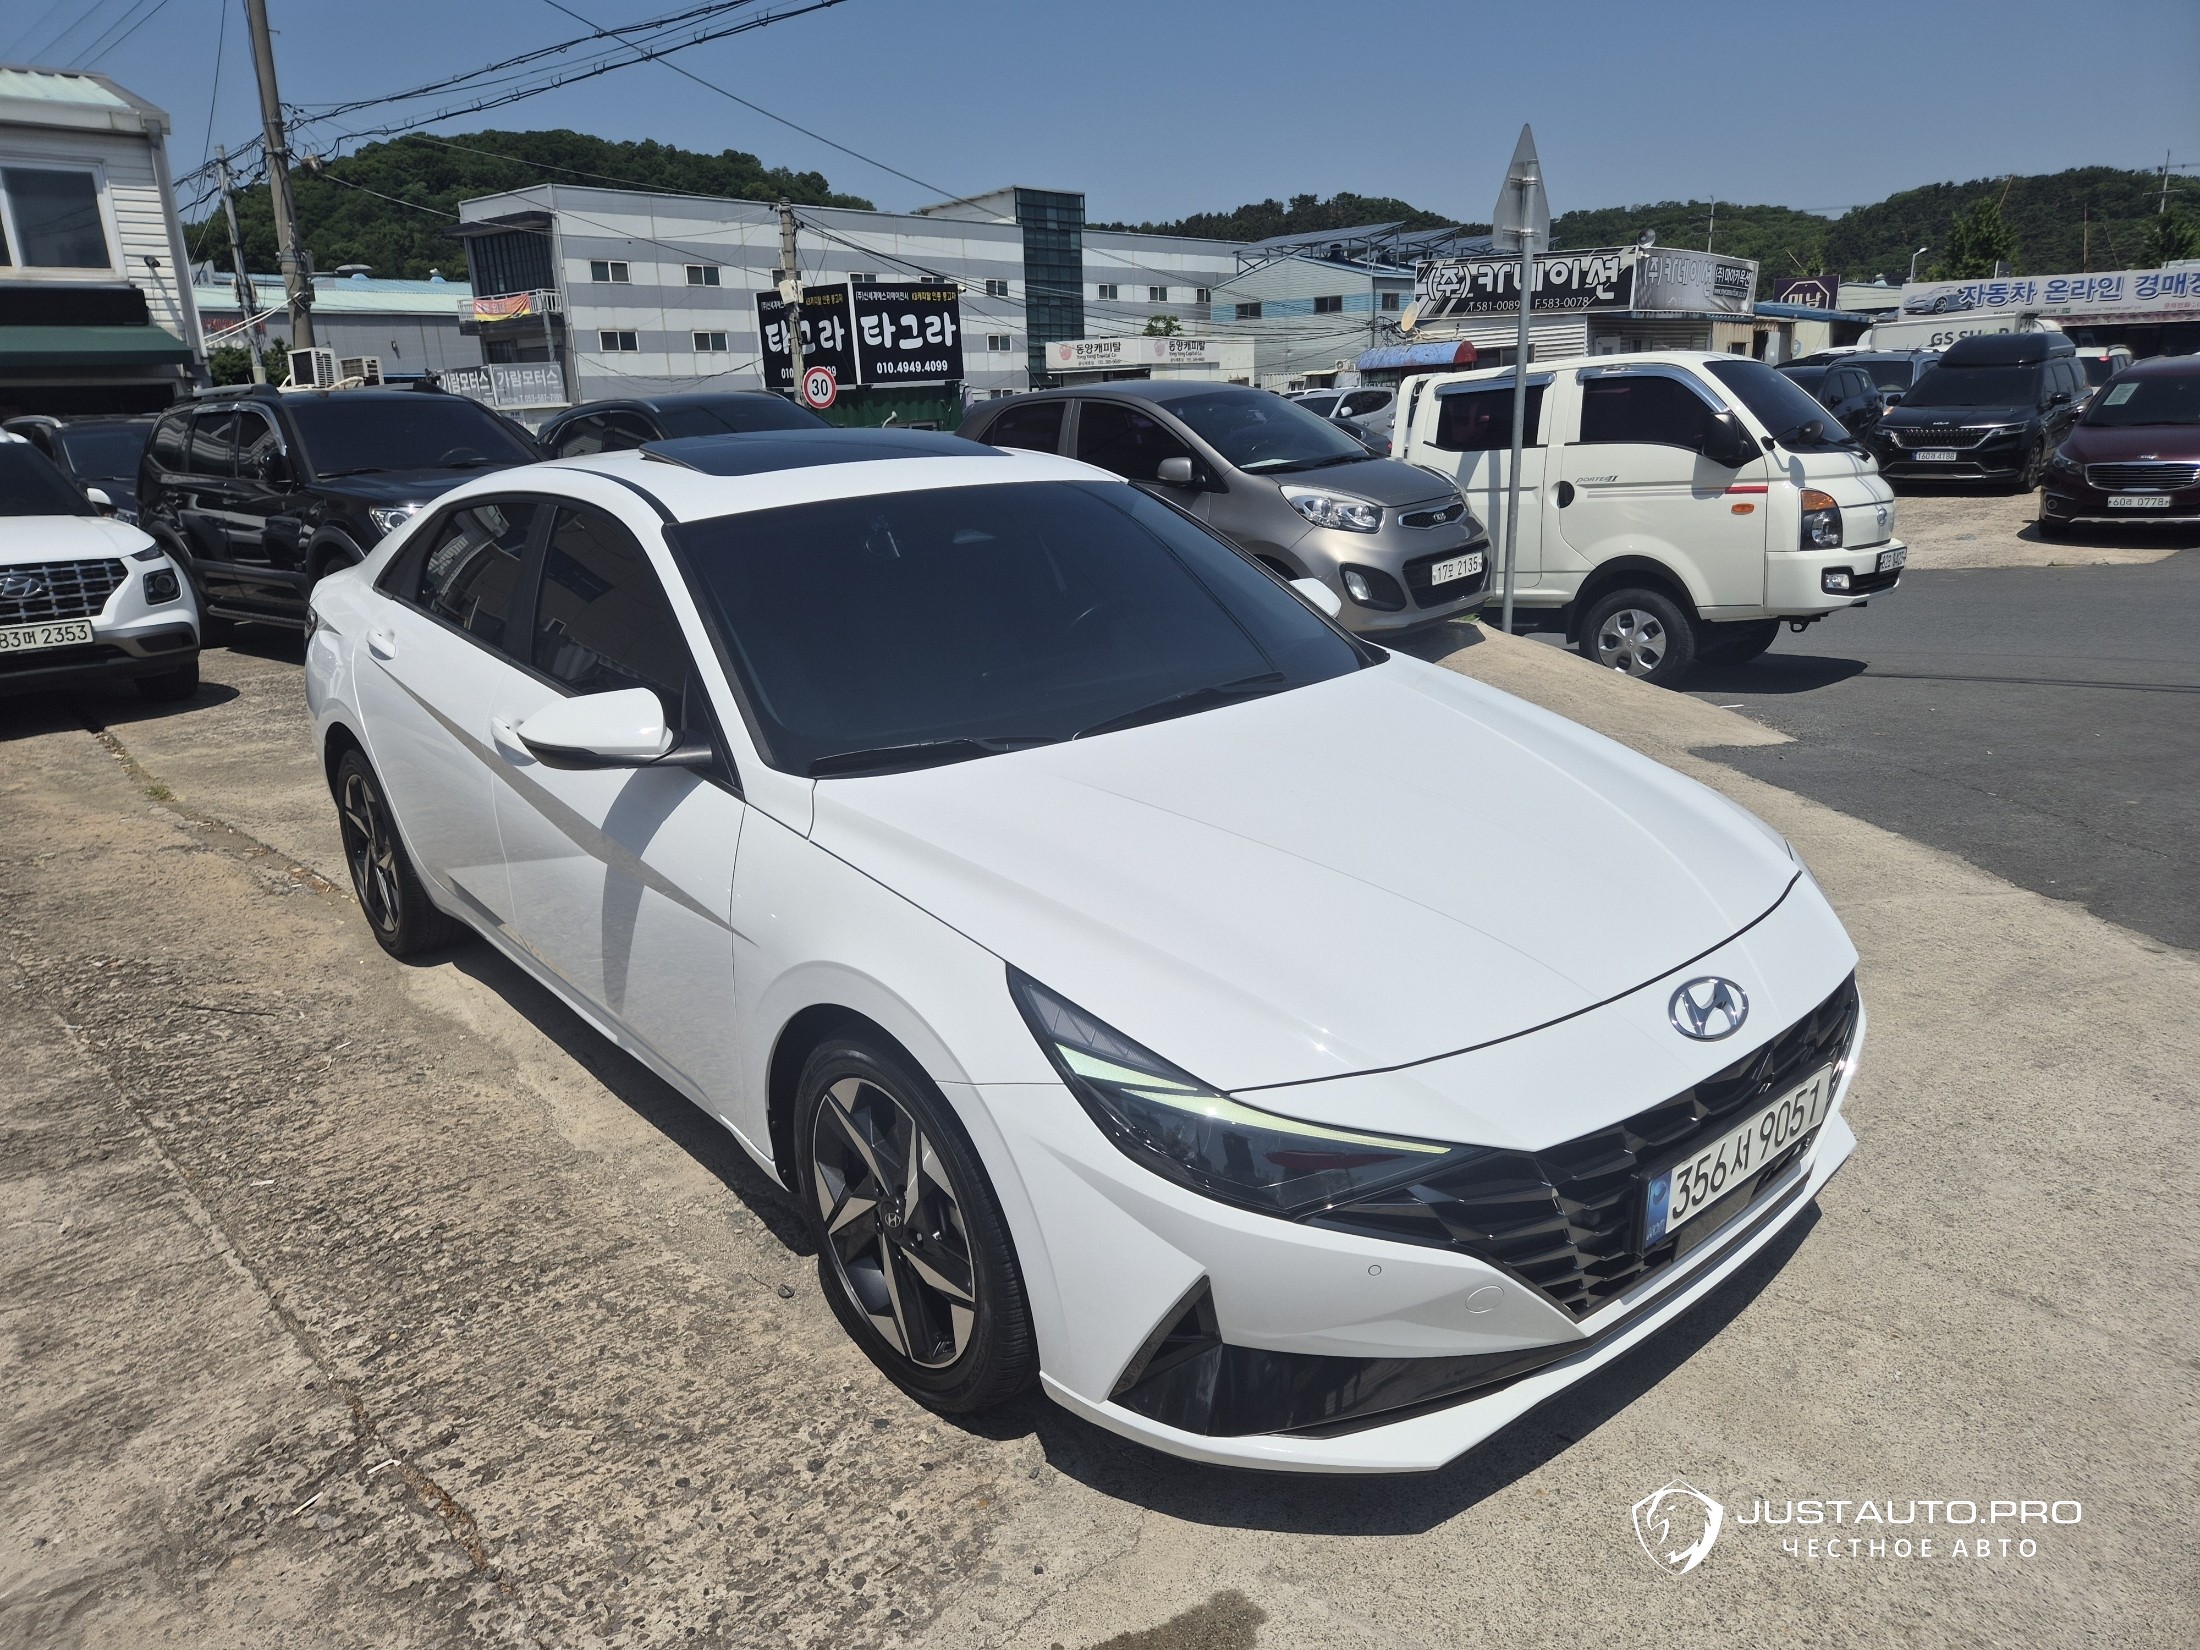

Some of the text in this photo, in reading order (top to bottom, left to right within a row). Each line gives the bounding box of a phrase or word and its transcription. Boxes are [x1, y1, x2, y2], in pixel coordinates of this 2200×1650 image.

[1961, 280, 2038, 306] 자동차
[2043, 276, 2124, 303] 온라인
[1469, 297, 1589, 312] T.581-0089 F.583-0078
[860, 311, 957, 350] 타그라
[1930, 331, 1954, 345] GS
[1076, 341, 1121, 355] 동양캐피탈
[1168, 340, 1206, 352] 동양캐피탈
[876, 359, 948, 374] 010.4949.4099
[441, 370, 490, 394] 가람모터스
[496, 369, 559, 388] 가람모터스
[811, 378, 829, 396] 30
[2137, 497, 2164, 507] 0778
[1457, 556, 1478, 576] 2135
[0, 624, 88, 648] 83머 2353
[1672, 1078, 1821, 1220] 356서 9051
